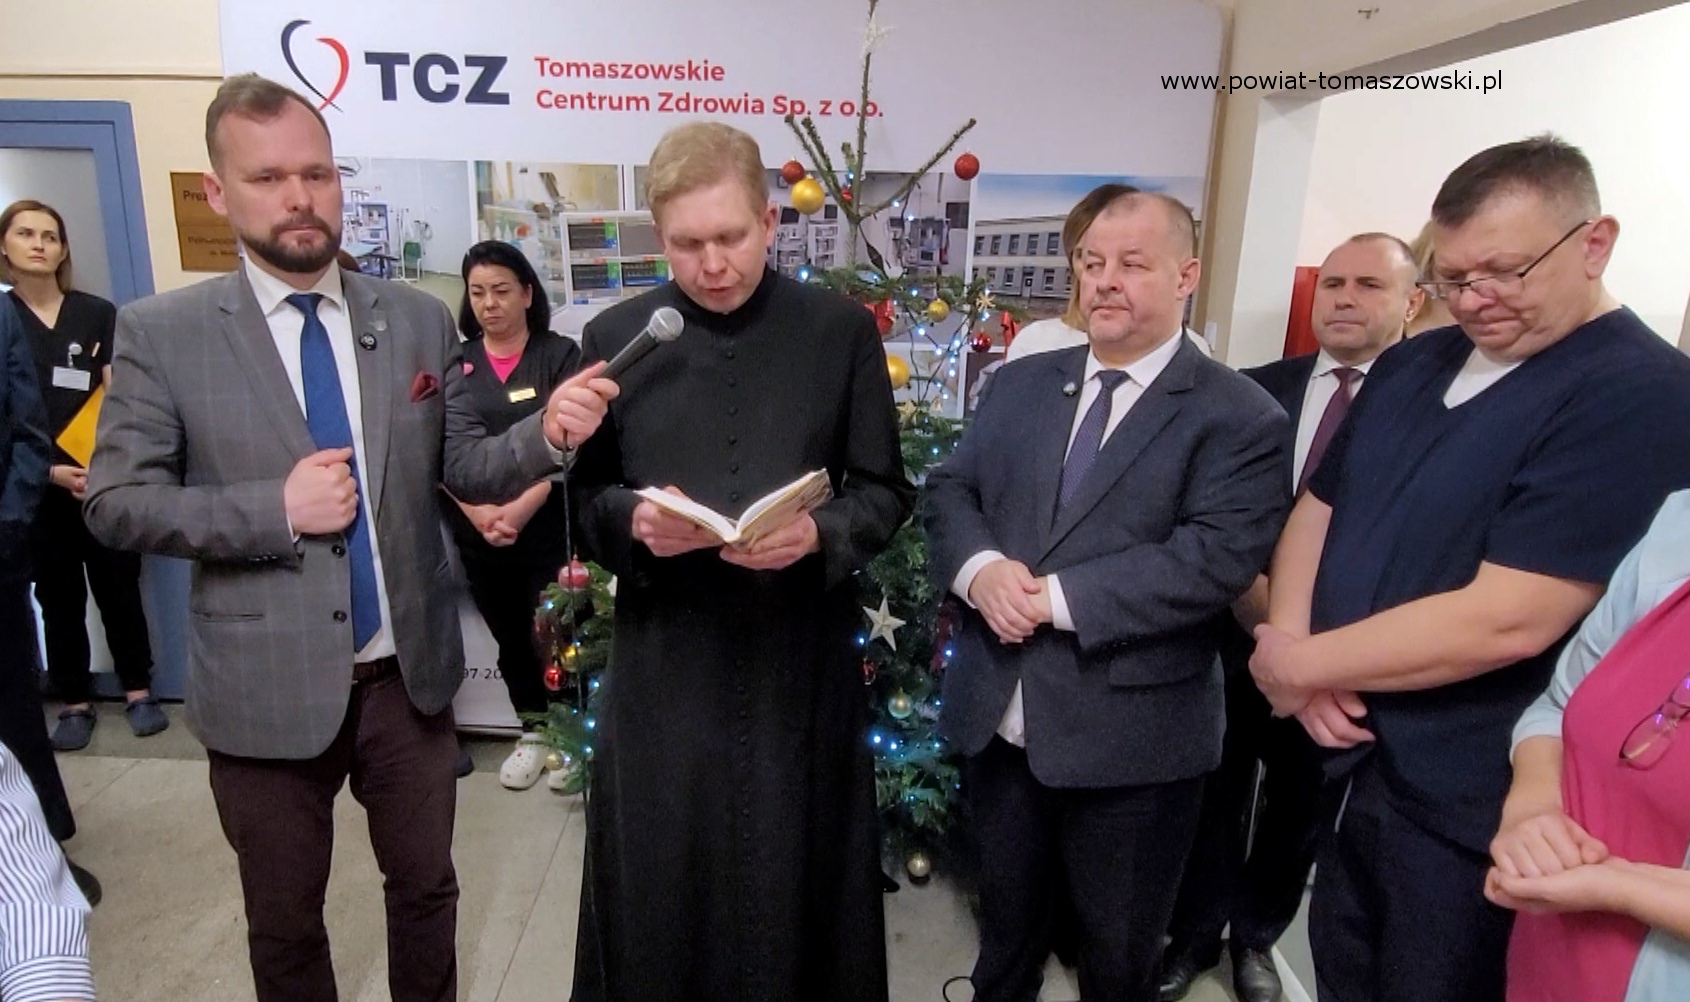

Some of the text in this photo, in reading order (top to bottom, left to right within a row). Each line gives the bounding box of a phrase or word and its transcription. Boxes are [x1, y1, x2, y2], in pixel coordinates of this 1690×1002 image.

[364, 51, 510, 105] TCZ
[534, 56, 725, 81] Tomaszowskie
[536, 89, 650, 111] Centrum
[658, 92, 765, 114] Zdrowia
[772, 95, 812, 118] Sp.
[819, 100, 832, 116] z
